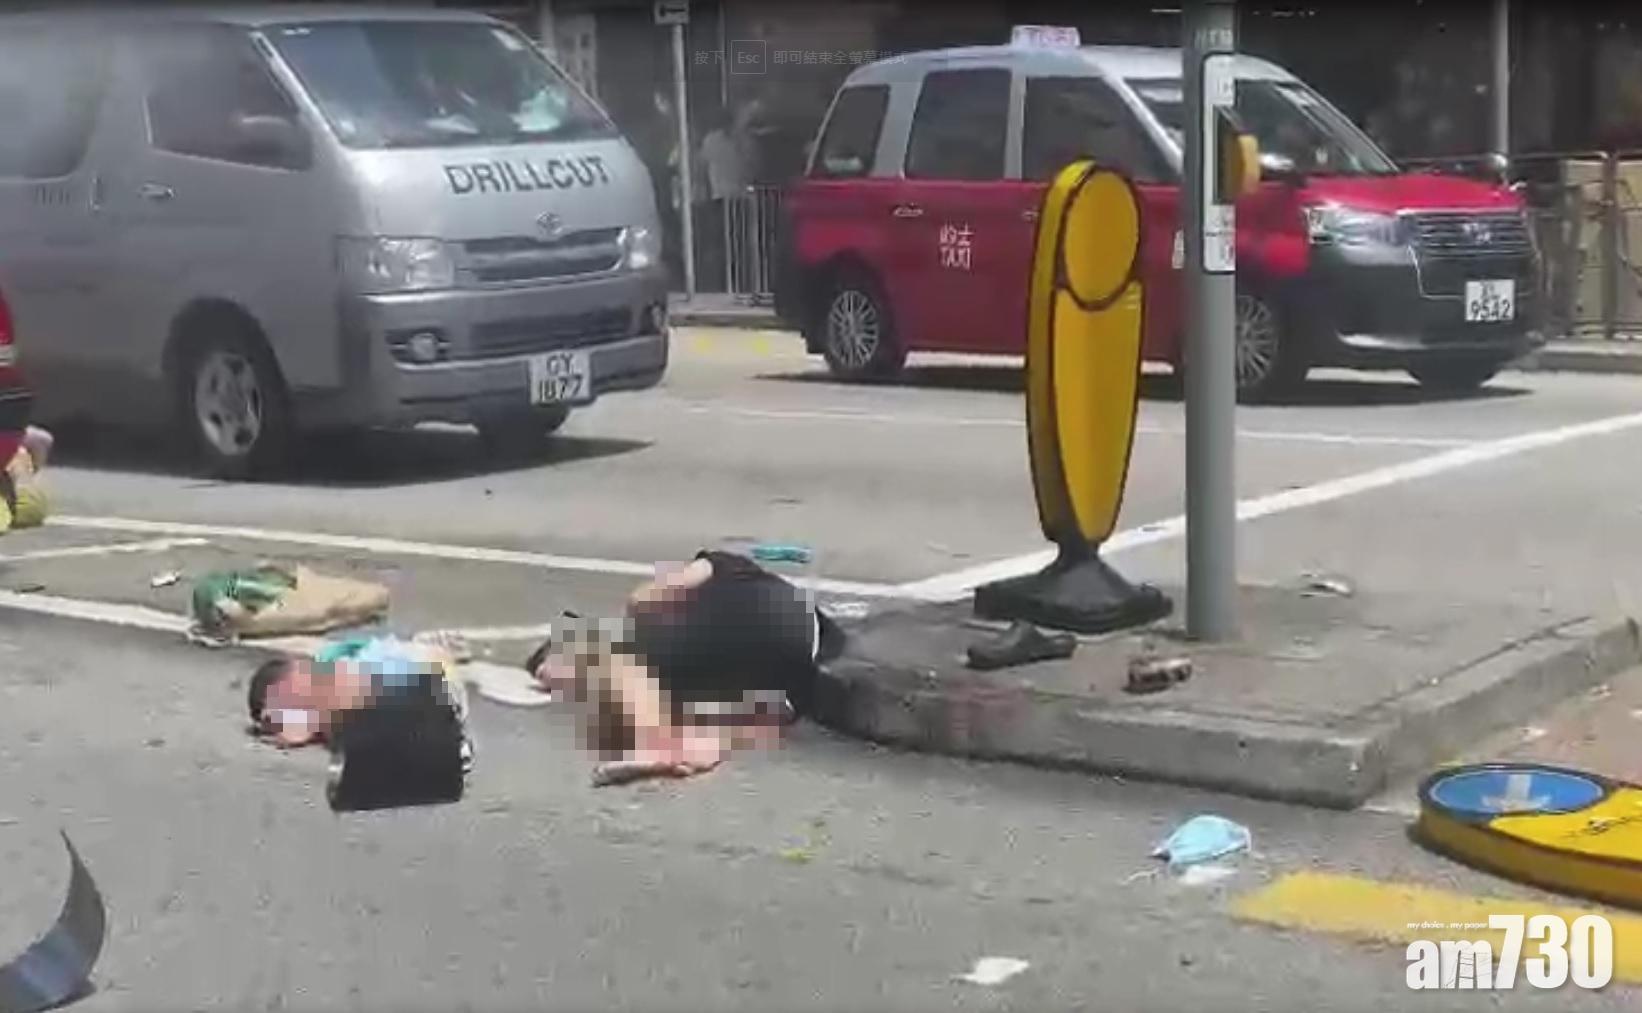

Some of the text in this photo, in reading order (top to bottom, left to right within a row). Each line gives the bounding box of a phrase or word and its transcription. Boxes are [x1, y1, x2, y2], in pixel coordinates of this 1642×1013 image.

[443, 156, 609, 195] DRILLCUT
[941, 247, 970, 270] TAXI
[1471, 299, 1511, 319] 9542
